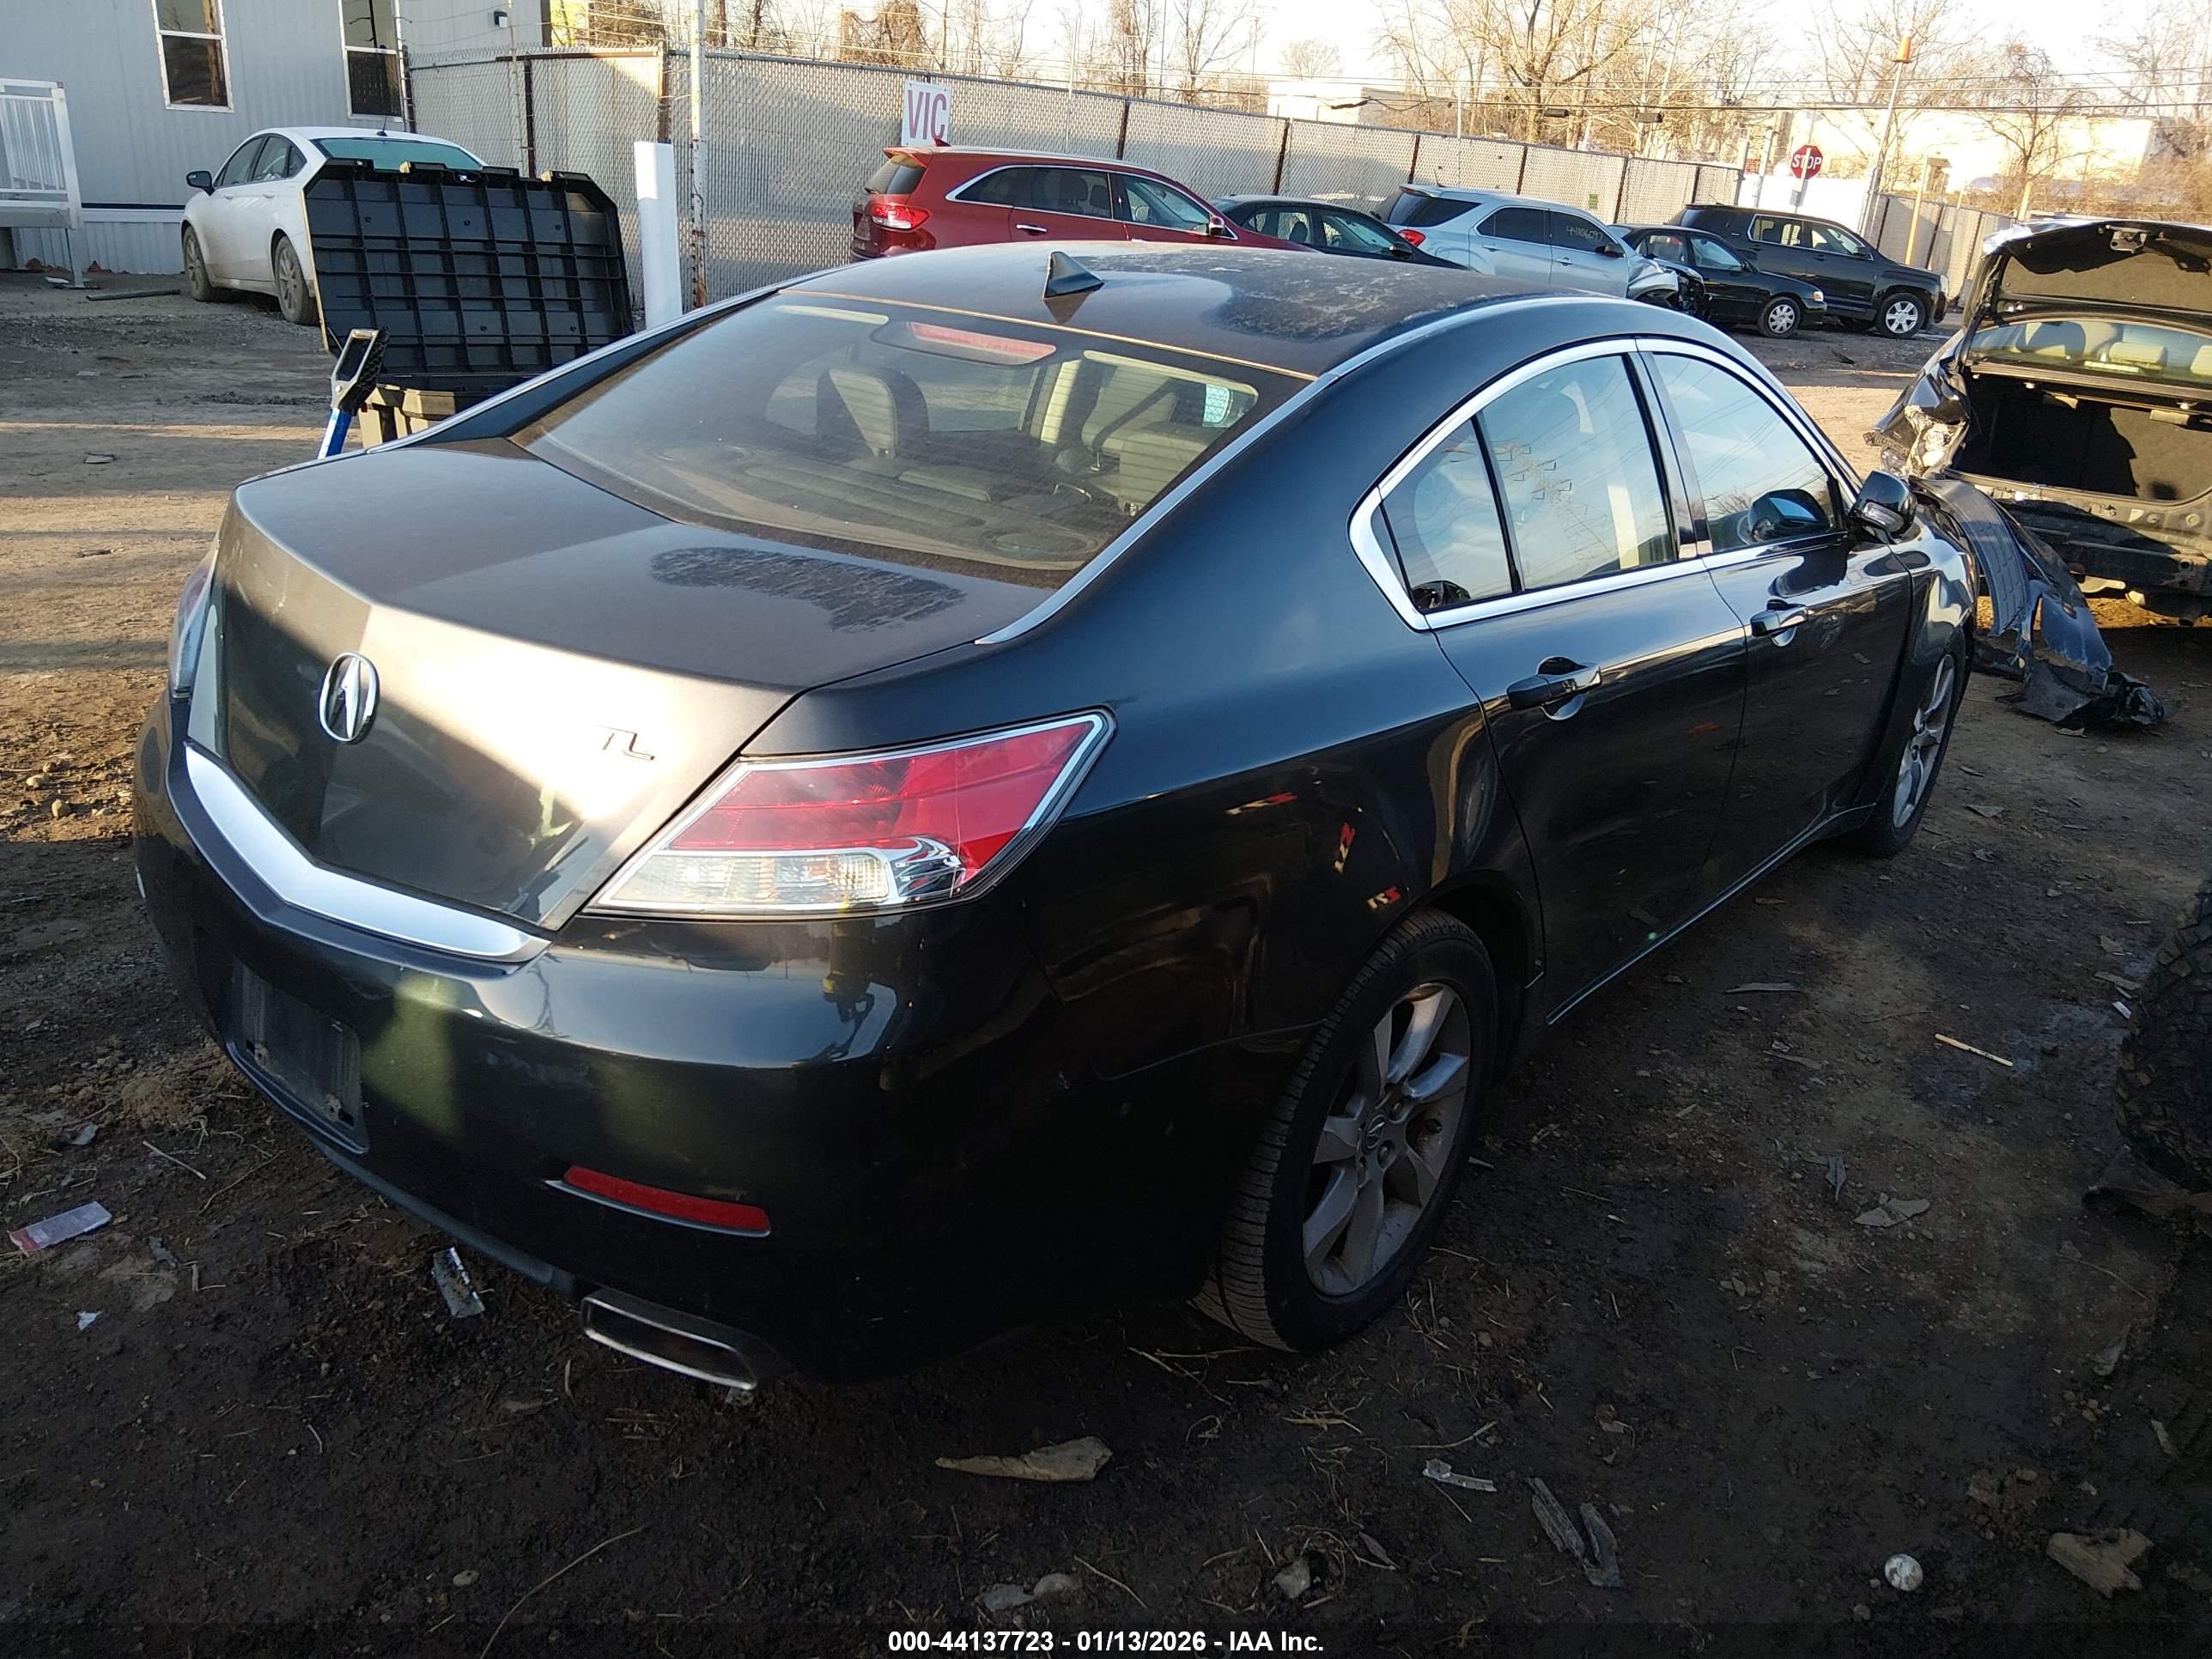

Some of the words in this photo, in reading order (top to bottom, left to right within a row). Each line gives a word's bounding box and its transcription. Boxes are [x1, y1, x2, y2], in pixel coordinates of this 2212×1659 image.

[907, 89, 947, 140] VIC
[1791, 154, 1822, 171] STOP
[598, 724, 655, 761] TL
